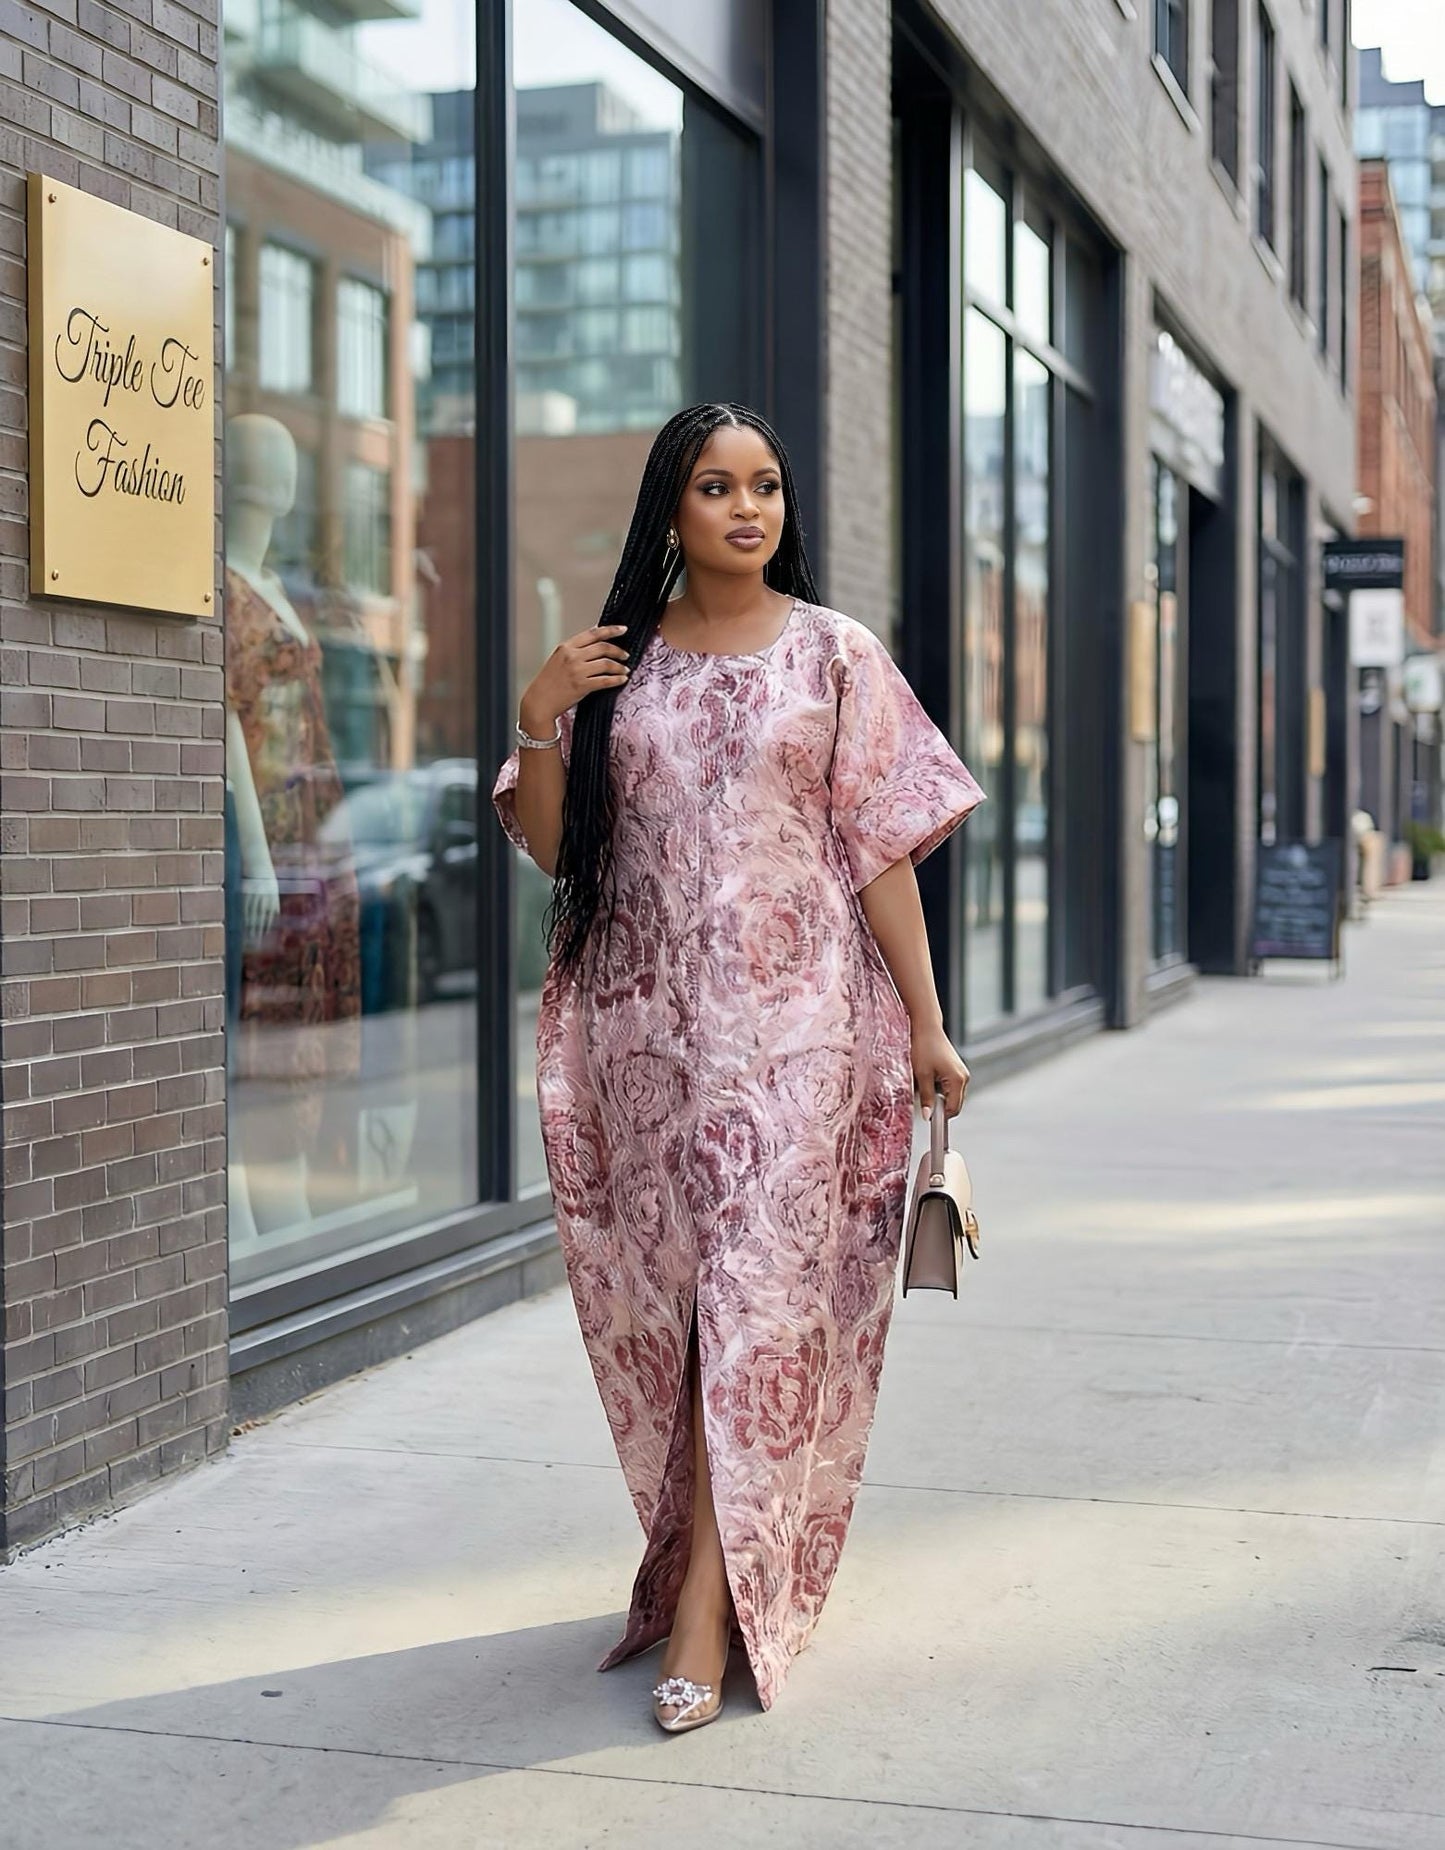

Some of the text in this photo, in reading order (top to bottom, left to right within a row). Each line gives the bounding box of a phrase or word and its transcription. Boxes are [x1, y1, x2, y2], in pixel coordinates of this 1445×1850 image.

[55, 307, 205, 410] Triple Tee
[75, 418, 186, 505] Fashion
